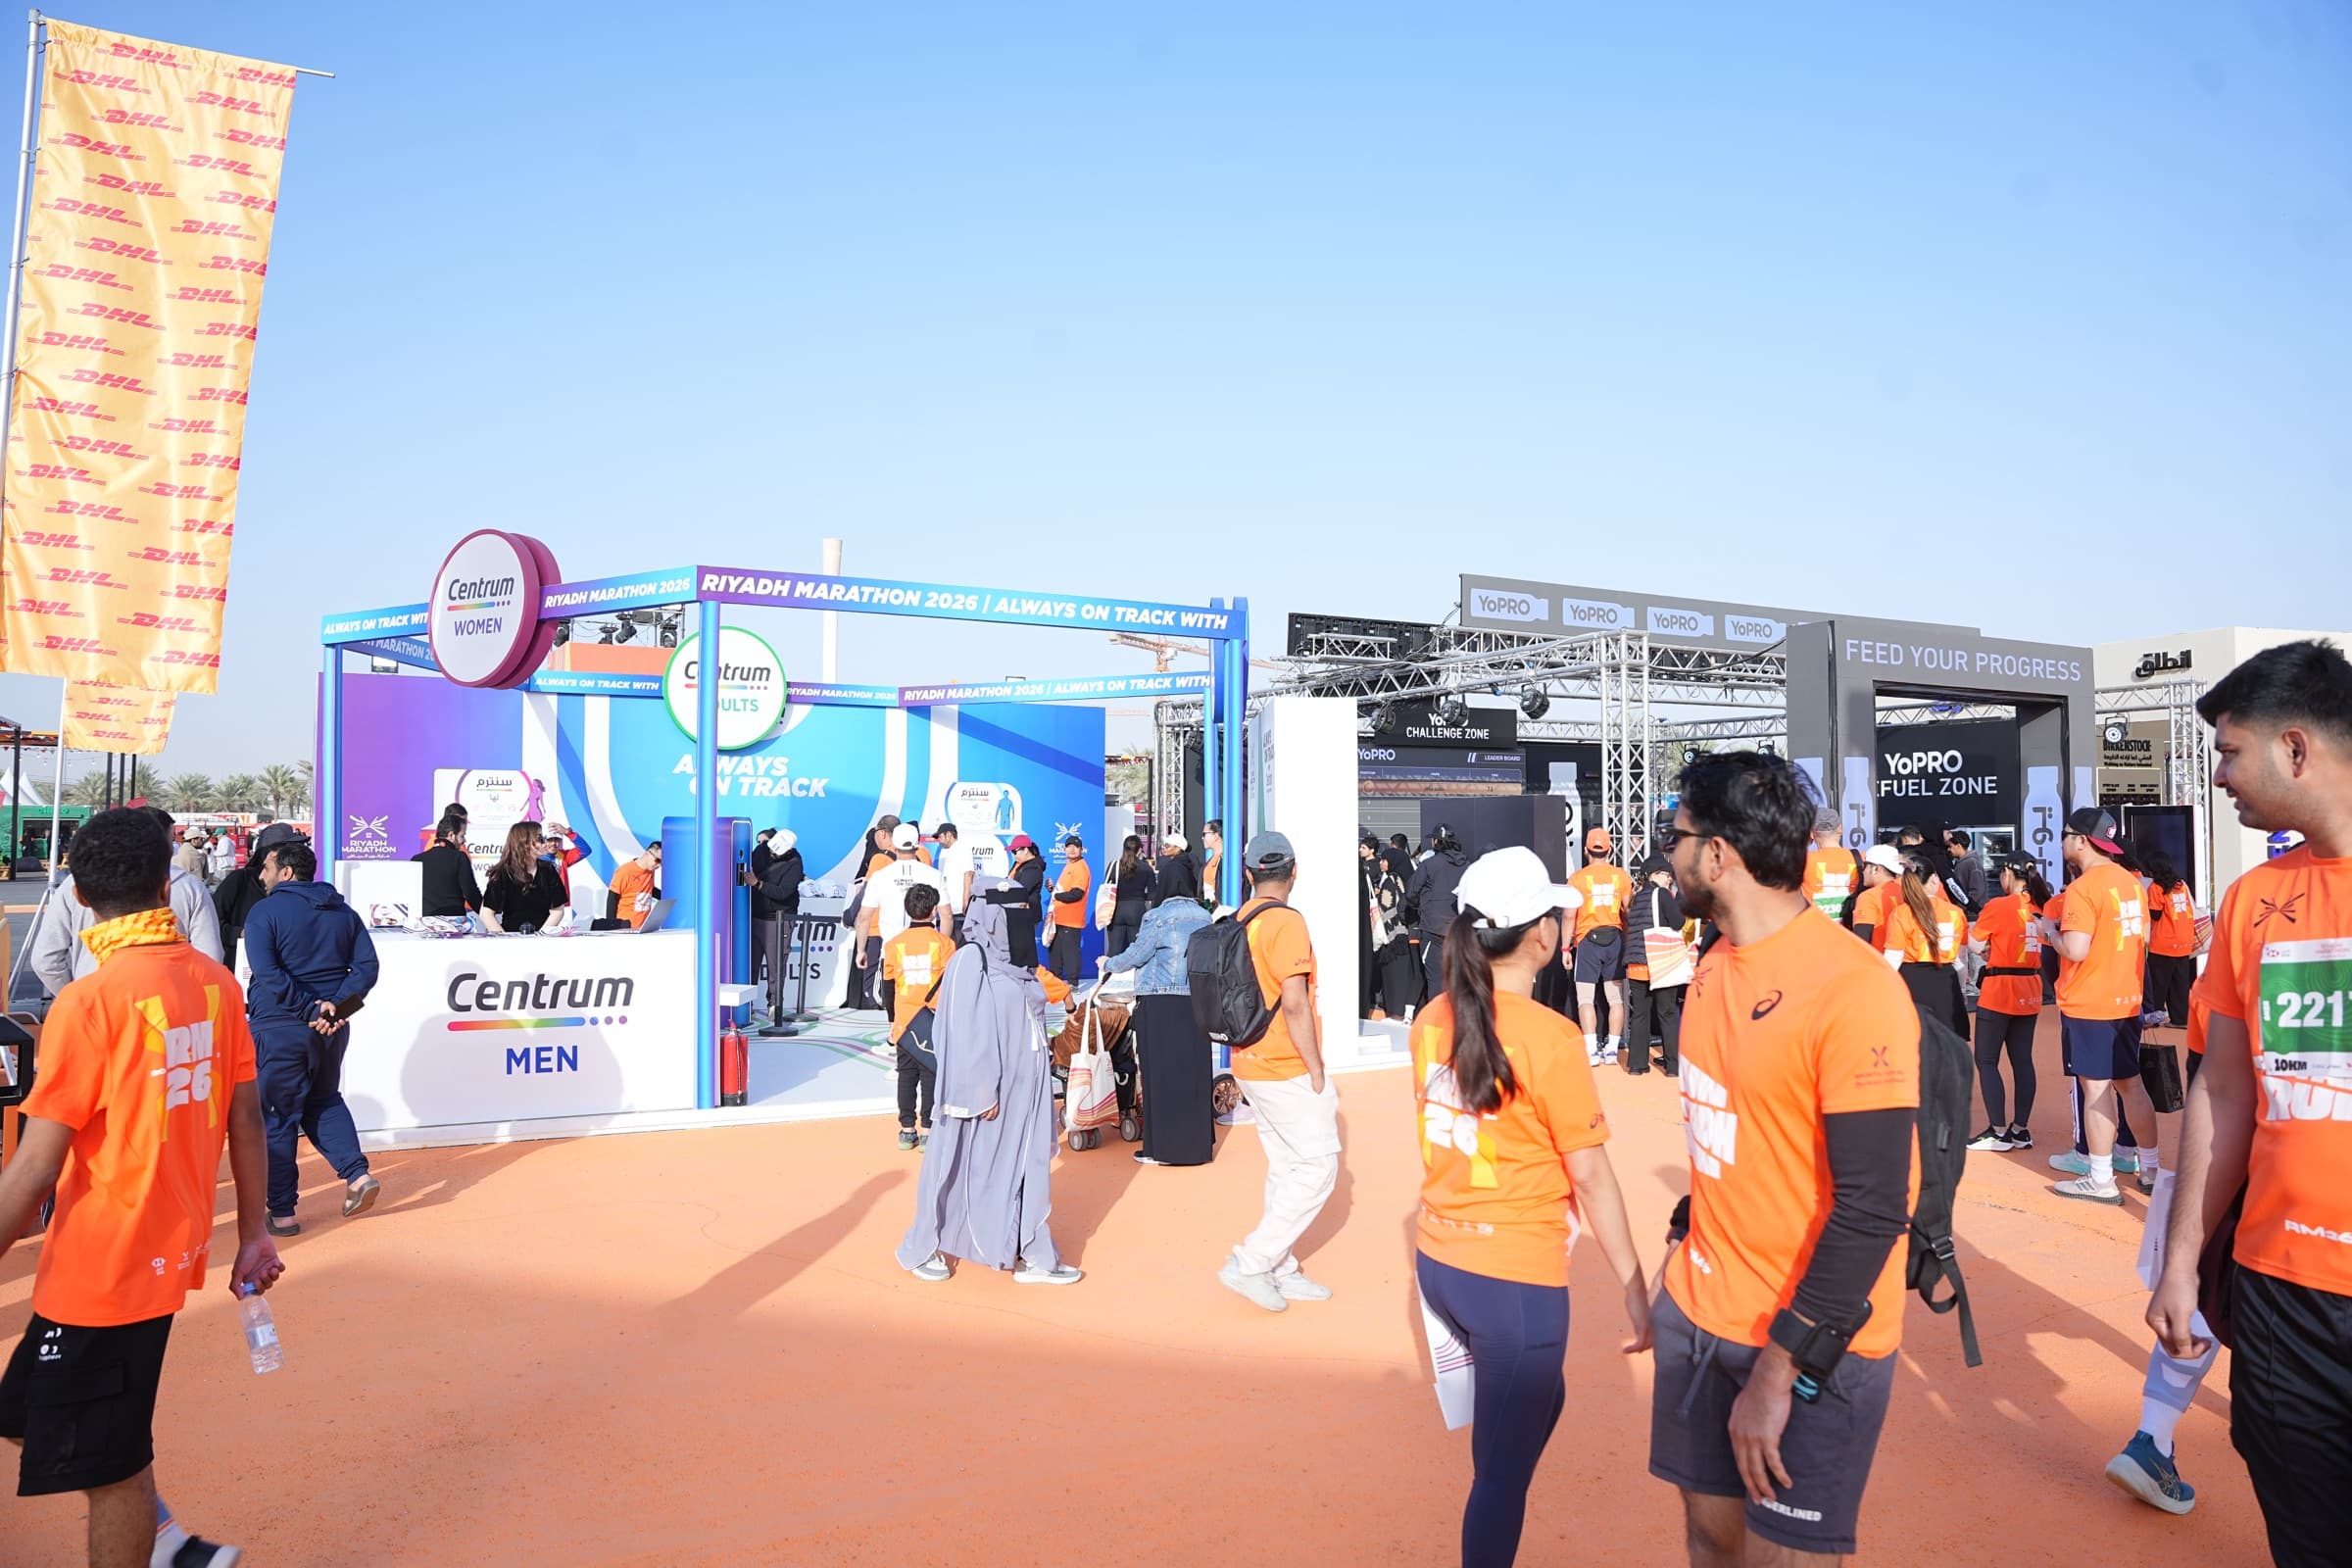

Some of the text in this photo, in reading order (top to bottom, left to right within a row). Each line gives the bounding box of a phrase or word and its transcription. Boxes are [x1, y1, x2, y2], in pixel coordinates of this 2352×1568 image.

[109, 42, 181, 68] DHL
[69, 70, 139, 92] DHL
[196, 91, 265, 116] DHL
[104, 109, 170, 129] DHL
[61, 132, 135, 160] DHL
[186, 155, 254, 177] DHL
[96, 173, 166, 196] DHL
[53, 198, 128, 222] DHL
[180, 220, 244, 238] DHL
[88, 237, 162, 264] DHL
[46, 264, 121, 287] DHL
[177, 287, 236, 304] DHL
[78, 303, 155, 328] DHL
[41, 332, 112, 352] DHL
[172, 353, 226, 368] DHL
[72, 369, 147, 394] DHL
[34, 397, 104, 418] DHL
[163, 418, 220, 434] DHL
[64, 435, 139, 459] DHL
[29, 464, 93, 483] DHL
[153, 483, 211, 500] DHL
[57, 501, 126, 522] DHL
[22, 531, 81, 550] DHL
[142, 547, 204, 565] DHL
[49, 568, 119, 588] DHL
[449, 577, 514, 601] Centrum
[545, 578, 690, 609] RIYADH MARATHON 2026
[17, 599, 74, 616] DHL
[701, 573, 790, 598] RIYADH
[794, 580, 922, 607] MARATHON
[924, 593, 978, 611] 2026
[994, 598, 1076, 620] ALWAYS
[1080, 604, 1110, 621] ON
[1114, 606, 1177, 626] TRACK
[1180, 612, 1228, 630] WITH
[1478, 595, 1531, 615] YoPRO
[131, 612, 197, 631] DHL
[324, 612, 429, 635] ALWAYS ON TRACK WIT
[1570, 604, 1618, 624] YoPRO
[1653, 612, 1698, 631] YoPRO
[455, 616, 502, 636] WOMEN
[1732, 620, 1773, 638] YoPRO
[45, 635, 106, 654] DHL
[1845, 639, 2082, 682] FEED YOUR PROGRESS
[684, 661, 771, 682] Ctrum
[535, 677, 577, 687] ALWAYS
[597, 680, 630, 690] TRACK
[633, 681, 660, 690] WITH
[787, 687, 820, 697] RIYADH
[821, 688, 873, 699] MARATHON
[905, 688, 946, 701] RIYADH
[947, 686, 1010, 699] MARATHON
[1015, 684, 1044, 697] 2026
[1054, 681, 1104, 695] ALWAYS
[1108, 679, 1126, 691] ON
[1129, 677, 1172, 690] TRACK
[1176, 674, 1210, 688] WITH
[97, 697, 133, 707] DHL
[75, 711, 113, 721] DHL
[93, 730, 131, 740] DHL
[1406, 727, 1490, 739] CHALLENGE ZONE
[672, 754, 789, 776] AWAYS
[1357, 749, 1396, 760] YoPRO
[1885, 750, 1963, 775] YoPRO
[739, 776, 830, 798] TRACK
[1877, 776, 1997, 797] FUEL ZONE
[447, 973, 634, 1011] Centrum
[2277, 991, 2352, 1028] 221
[164, 1019, 214, 1069] RM
[506, 1046, 578, 1075] MEN
[2275, 1058, 2308, 1072] 10KM
[166, 1059, 213, 1111] 26
